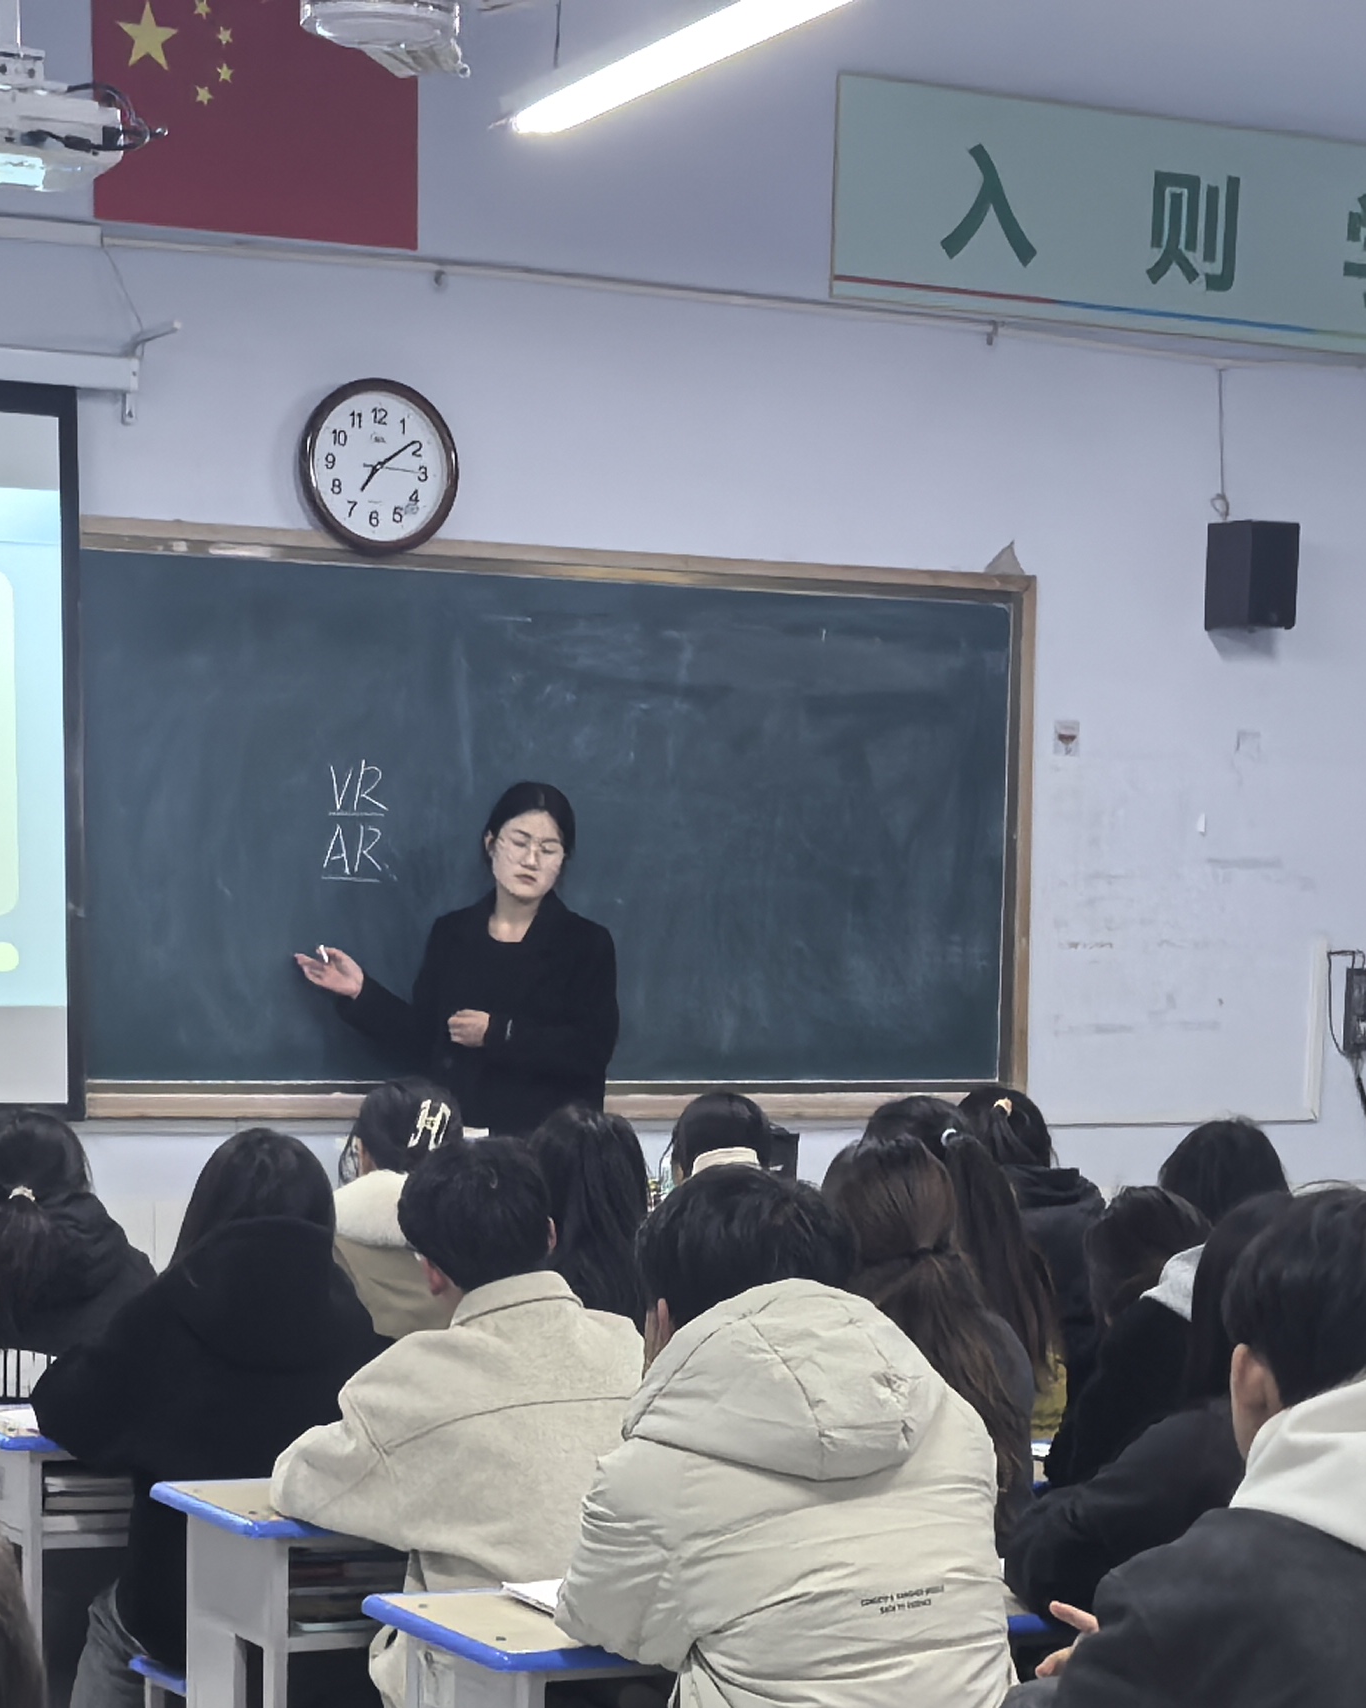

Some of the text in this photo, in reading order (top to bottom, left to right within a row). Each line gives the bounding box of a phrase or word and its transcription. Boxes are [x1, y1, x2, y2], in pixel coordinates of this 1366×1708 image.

[349, 410, 363, 429] 11
[371, 407, 388, 426] 12
[399, 417, 406, 435] 1
[332, 429, 348, 447] 10
[411, 440, 423, 458] 2
[324, 452, 336, 470] 9
[417, 465, 429, 483] 3
[330, 478, 343, 495] 8
[408, 489, 420, 505] 4
[347, 500, 358, 518] 7
[392, 505, 404, 523] 5
[368, 510, 380, 528] 6
[329, 759, 389, 811] VR
[323, 823, 382, 875] AR
